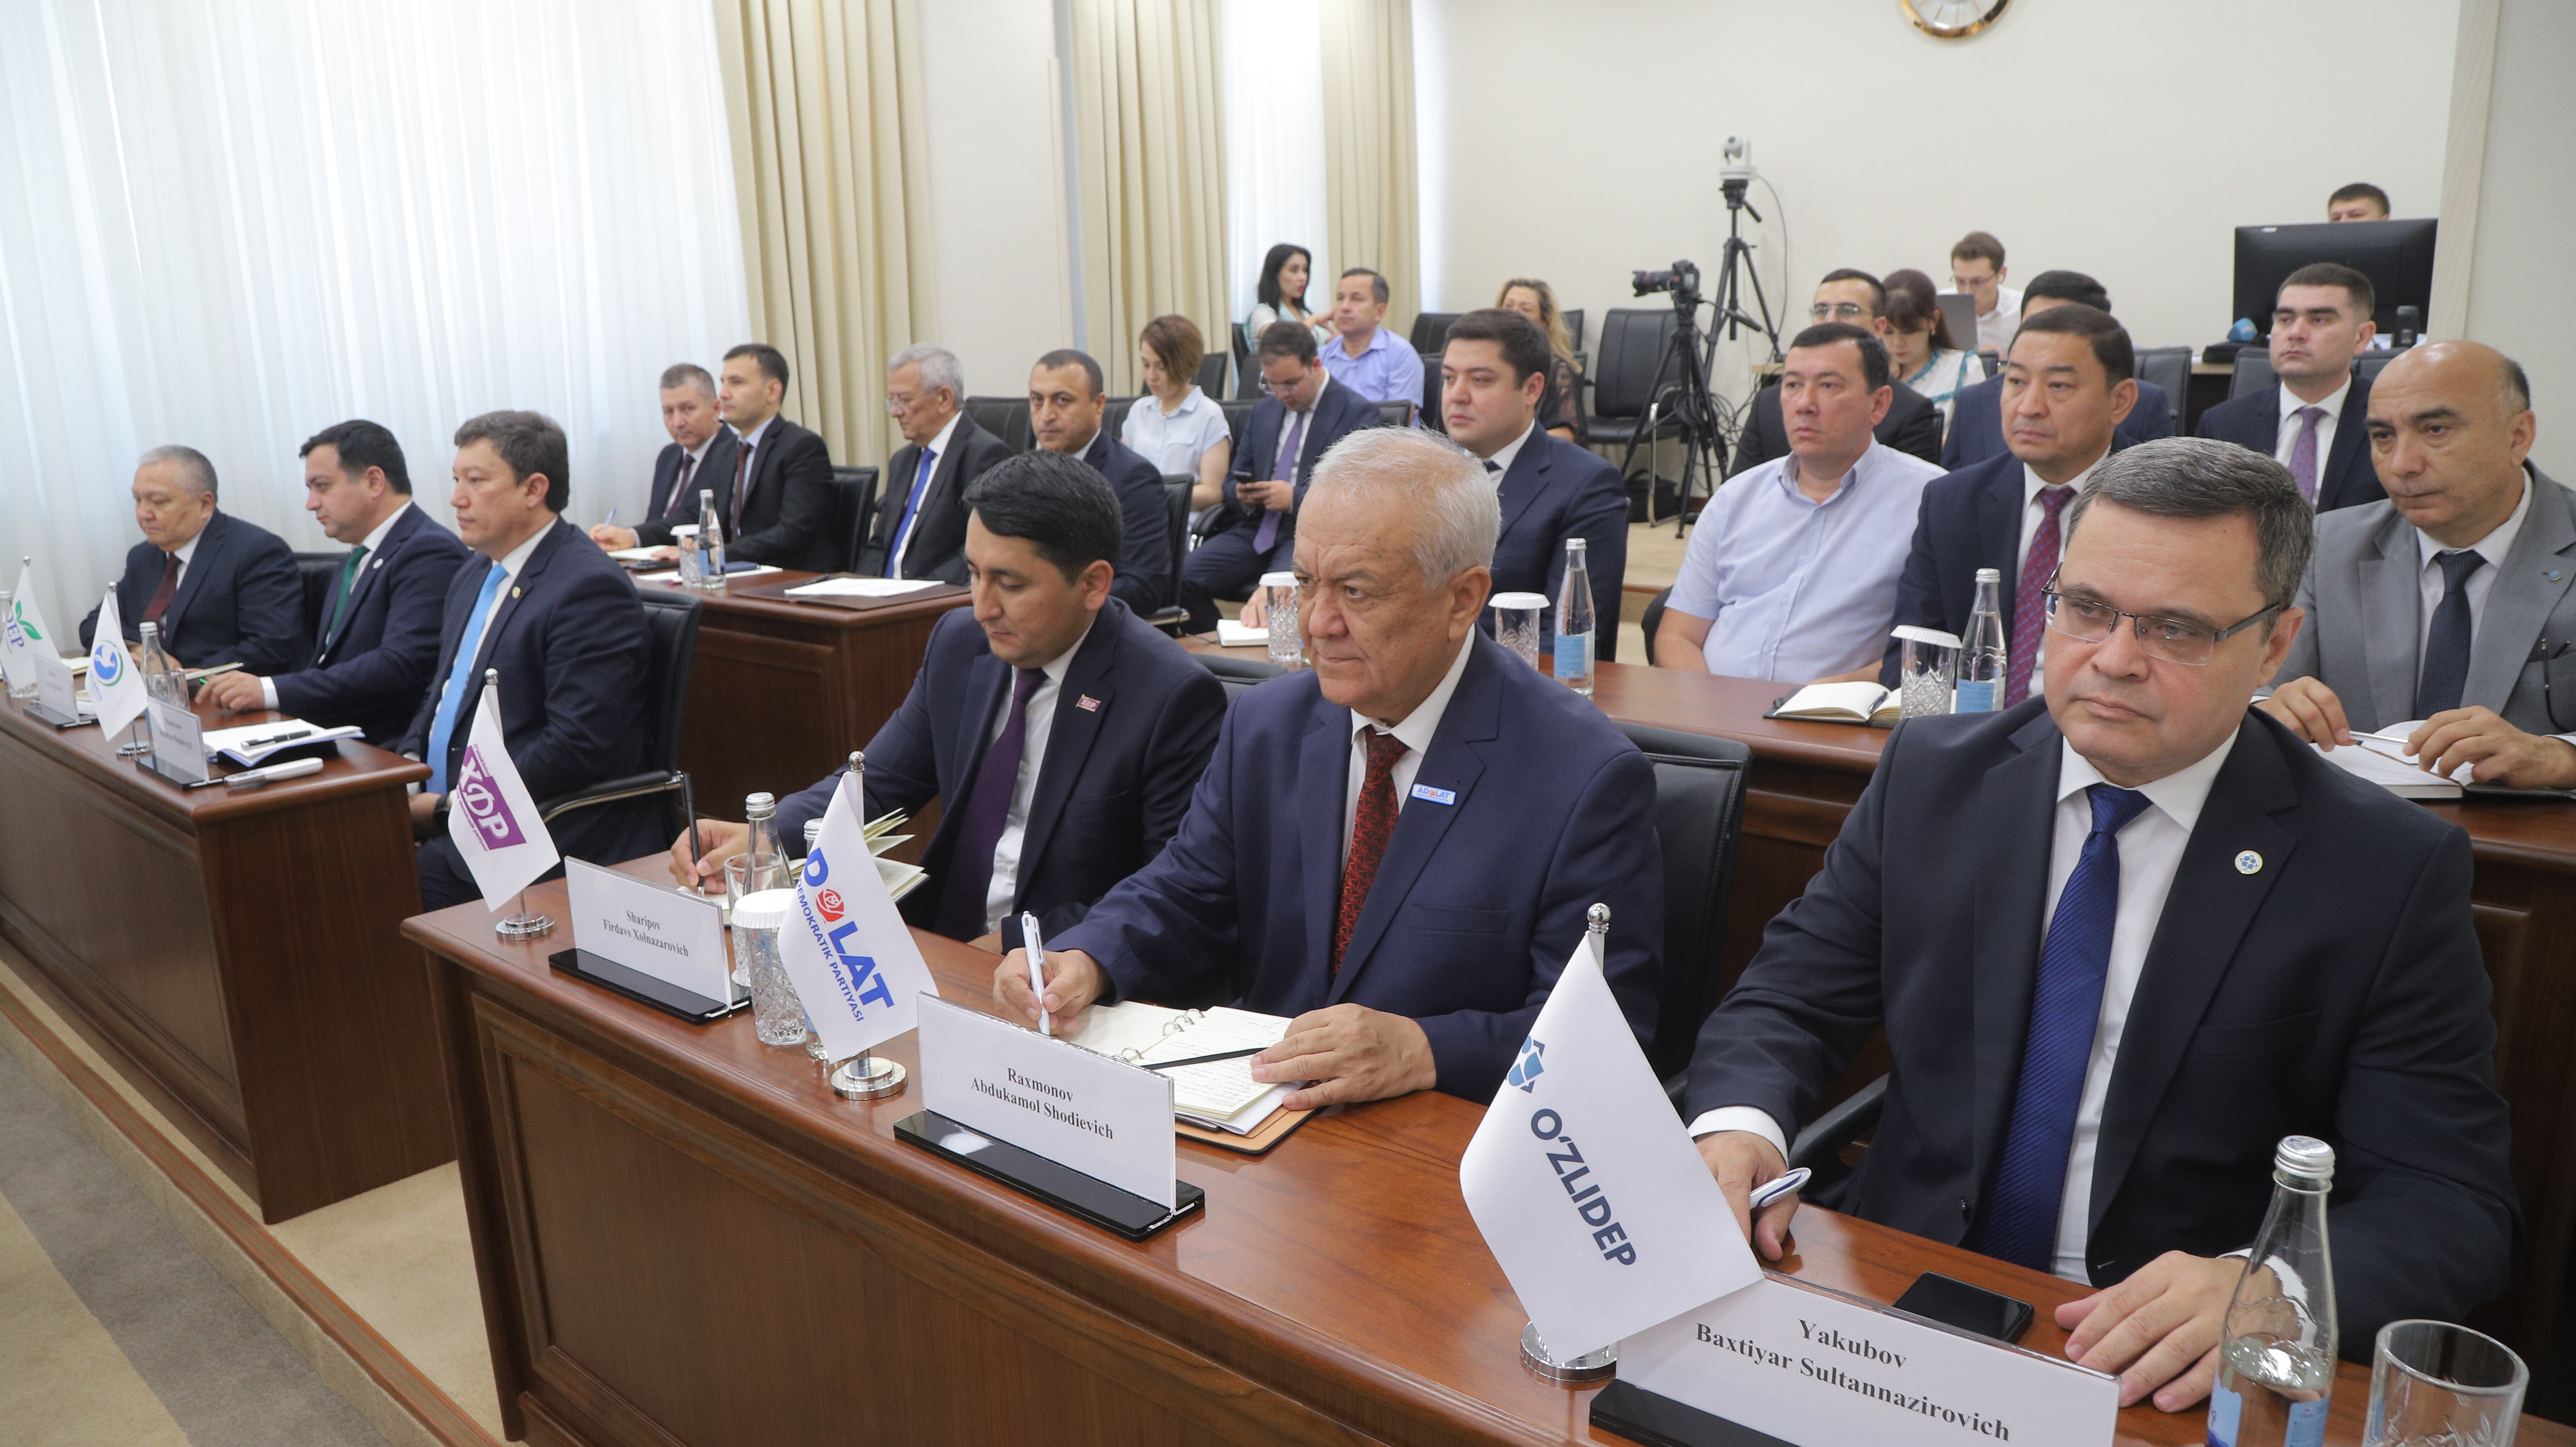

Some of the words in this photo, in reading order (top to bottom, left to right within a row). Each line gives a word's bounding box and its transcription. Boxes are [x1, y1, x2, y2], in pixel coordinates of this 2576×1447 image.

[460, 756, 510, 839] XDP
[603, 919, 632, 937] Firdavs
[632, 929, 689, 957] Xolnazarovich
[626, 910, 661, 930] Sharipov
[797, 878, 833, 960] DEMOKRATIK
[829, 961, 865, 1022] PARTIYASI
[971, 1077, 1041, 1113] Abdukamol
[1044, 1102, 1113, 1139] Shodievich
[1006, 1067, 1074, 1102] Raxmonov
[1798, 1319, 1908, 1368] Yakubov
[1695, 1323, 1793, 1369] Baxtiyar
[1800, 1357, 2010, 1442] Sultannazirovich
